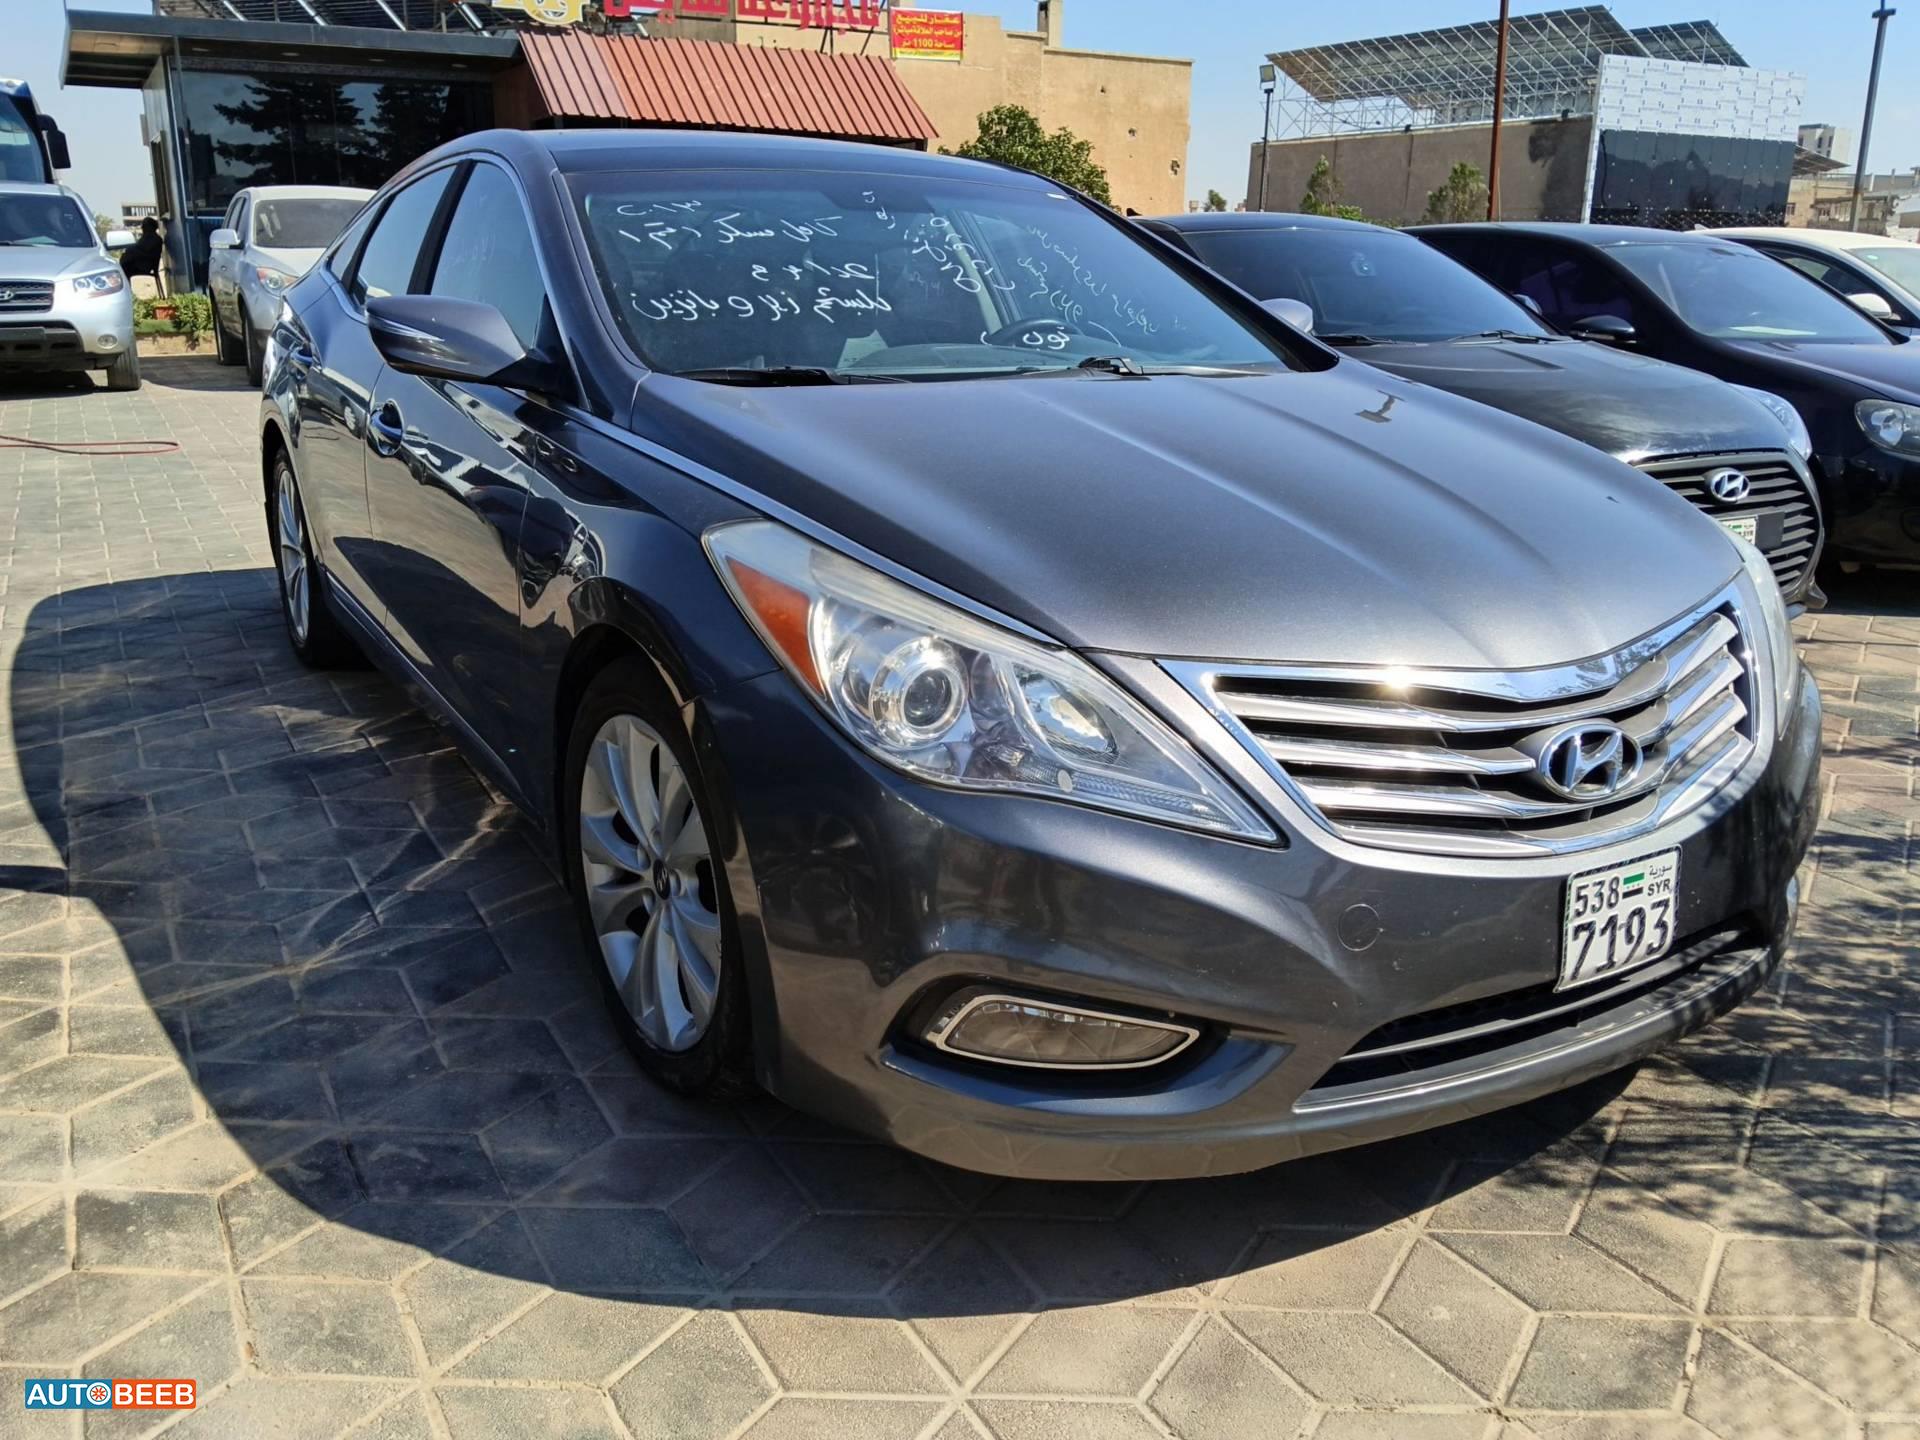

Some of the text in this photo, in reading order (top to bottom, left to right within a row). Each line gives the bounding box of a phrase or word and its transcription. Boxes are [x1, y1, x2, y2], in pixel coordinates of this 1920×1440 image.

[913, 38, 933, 48] 1100
[1649, 864, 1673, 880] سورية
[1574, 876, 1620, 918] 538
[1647, 878, 1671, 897] SYR
[1570, 897, 1671, 981] 7193
